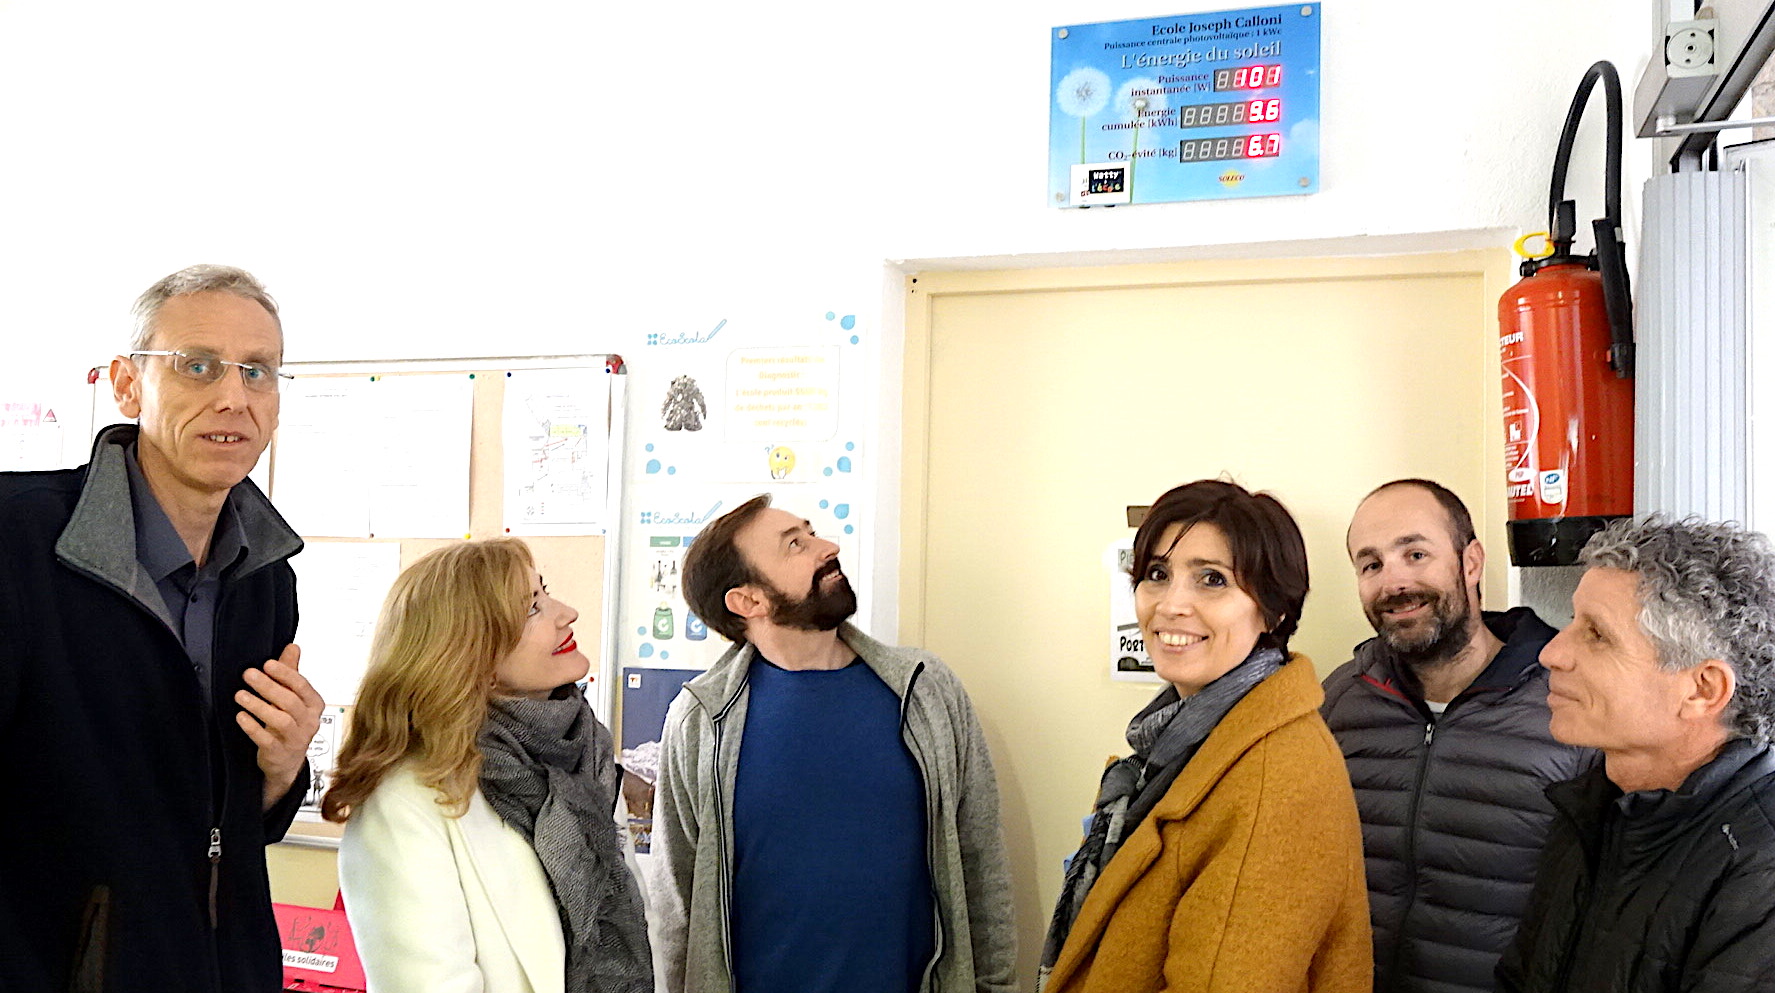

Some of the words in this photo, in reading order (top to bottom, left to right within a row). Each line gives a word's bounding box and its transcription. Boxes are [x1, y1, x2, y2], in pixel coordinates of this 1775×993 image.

[1152, 22, 1186, 36] Ecole
[1189, 18, 1232, 34] Joseph
[1234, 13, 1282, 29] Calloni
[1104, 41, 1146, 50] Puissance
[1147, 36, 1182, 47] centrale
[1263, 27, 1282, 36] kWc
[1121, 47, 1202, 70] L'énergie
[1206, 46, 1229, 62] du
[1234, 40, 1281, 60] soleil
[1158, 73, 1209, 84] Puissance
[1240, 65, 1280, 88] 101
[1131, 85, 1191, 97] instantanée
[1101, 119, 1145, 132] cumulée
[1148, 117, 1178, 129] [kWh]
[1159, 147, 1178, 159] [kg]
